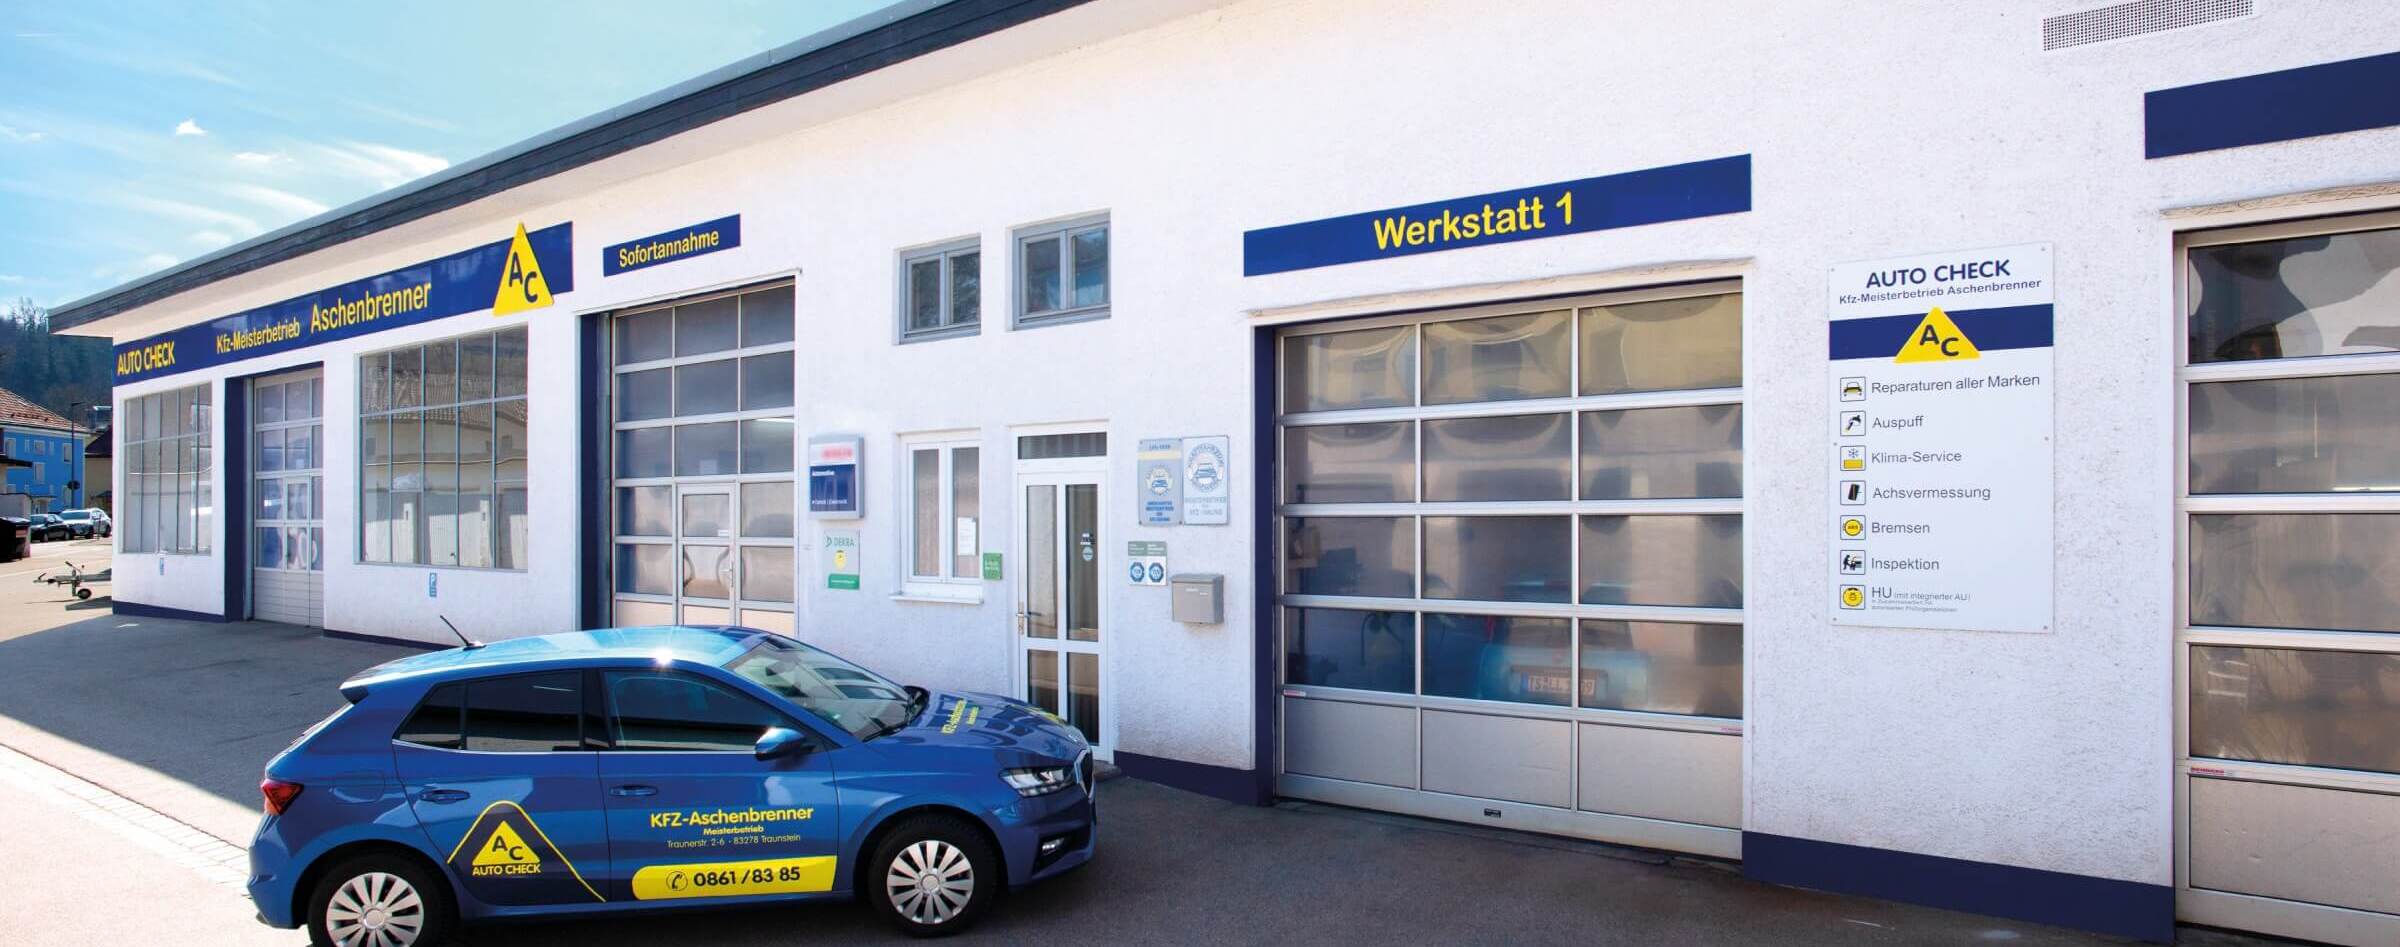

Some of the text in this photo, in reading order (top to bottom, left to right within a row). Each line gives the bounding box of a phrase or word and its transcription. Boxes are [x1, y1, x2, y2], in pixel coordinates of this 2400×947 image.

[1374, 191, 1573, 250] Werkstatt 1
[619, 230, 720, 268] Sofortannahme
[1866, 259, 2011, 289] AUTO CHECK
[1839, 279, 2042, 305] Kfz-Meisterbetrieb Aschenbrenner
[117, 282, 432, 376] AUTO CHECK Kfz-Meisterbetrieb Aschenbrenner
[1871, 374, 2041, 395] Reparaturen aller Marken
[1872, 415, 1924, 431] Auspuff
[1871, 450, 1963, 464] Klima-Service
[1872, 487, 1991, 501] Achsvermessung
[1871, 522, 1931, 534] Bremsen
[1871, 557, 1940, 572] Inspektion
[1871, 586, 1892, 599] HU
[650, 807, 814, 828] KFZ-Aschenbrenner
[703, 825, 764, 836] Meisterbetrieb
[667, 840, 708, 849] Traunerstr.
[733, 836, 759, 845] 83278
[761, 834, 801, 844] Traunstein
[472, 863, 541, 876] AUTO CHECK
[693, 871, 736, 887] 0861
[779, 867, 801, 881] 85
